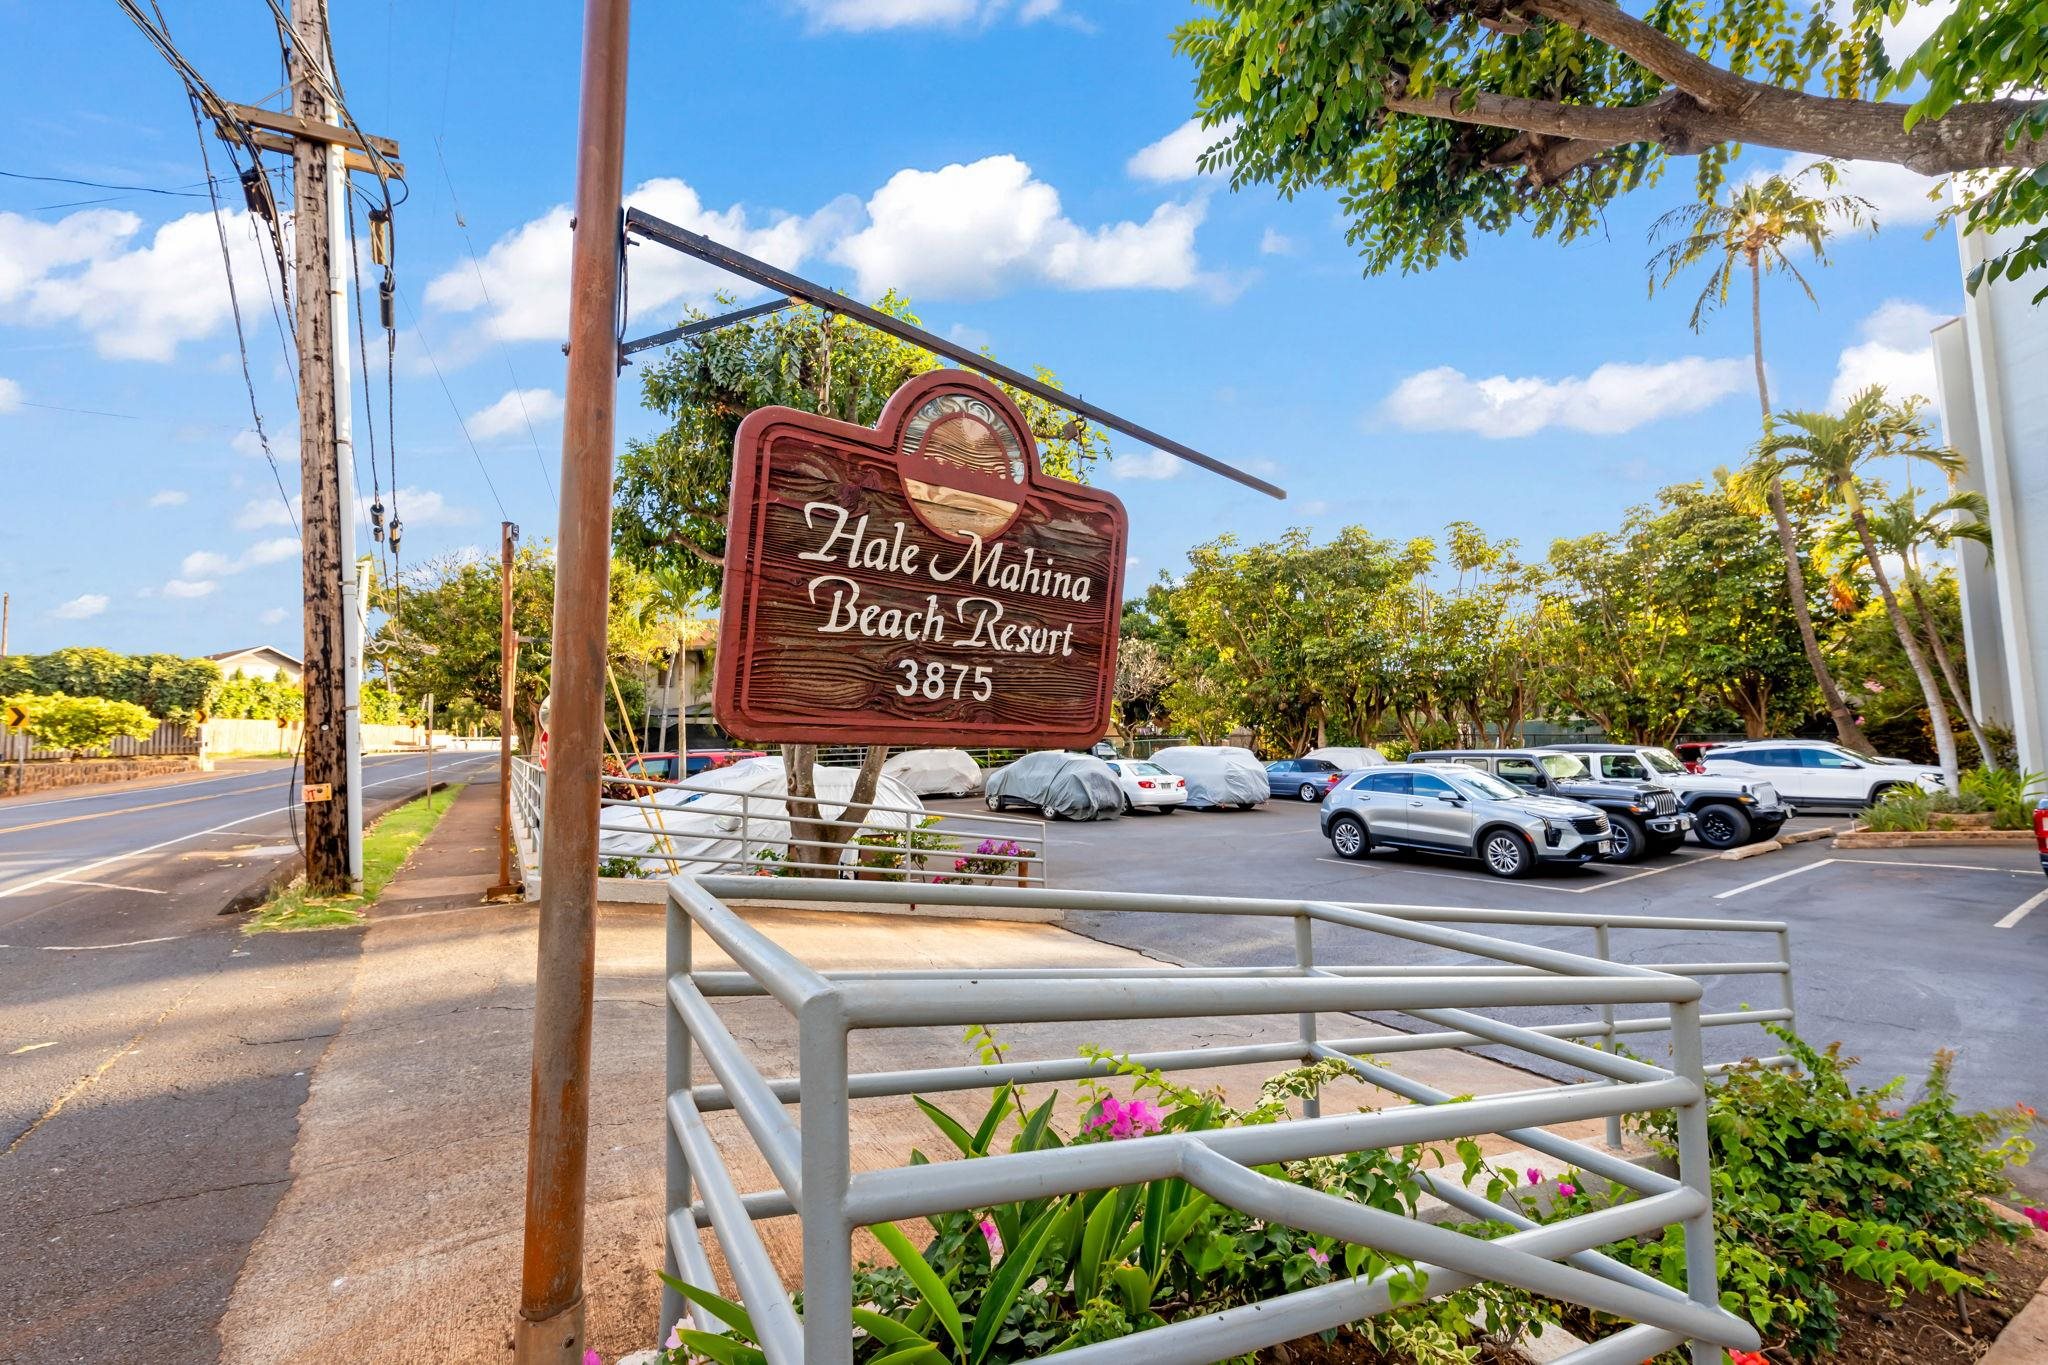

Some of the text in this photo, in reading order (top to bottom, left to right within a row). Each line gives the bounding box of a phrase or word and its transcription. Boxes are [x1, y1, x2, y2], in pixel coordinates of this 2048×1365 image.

[798, 501, 1092, 603] Hale Mahina
[808, 575, 1074, 657] Beach Resort
[895, 659, 993, 702] 3875
